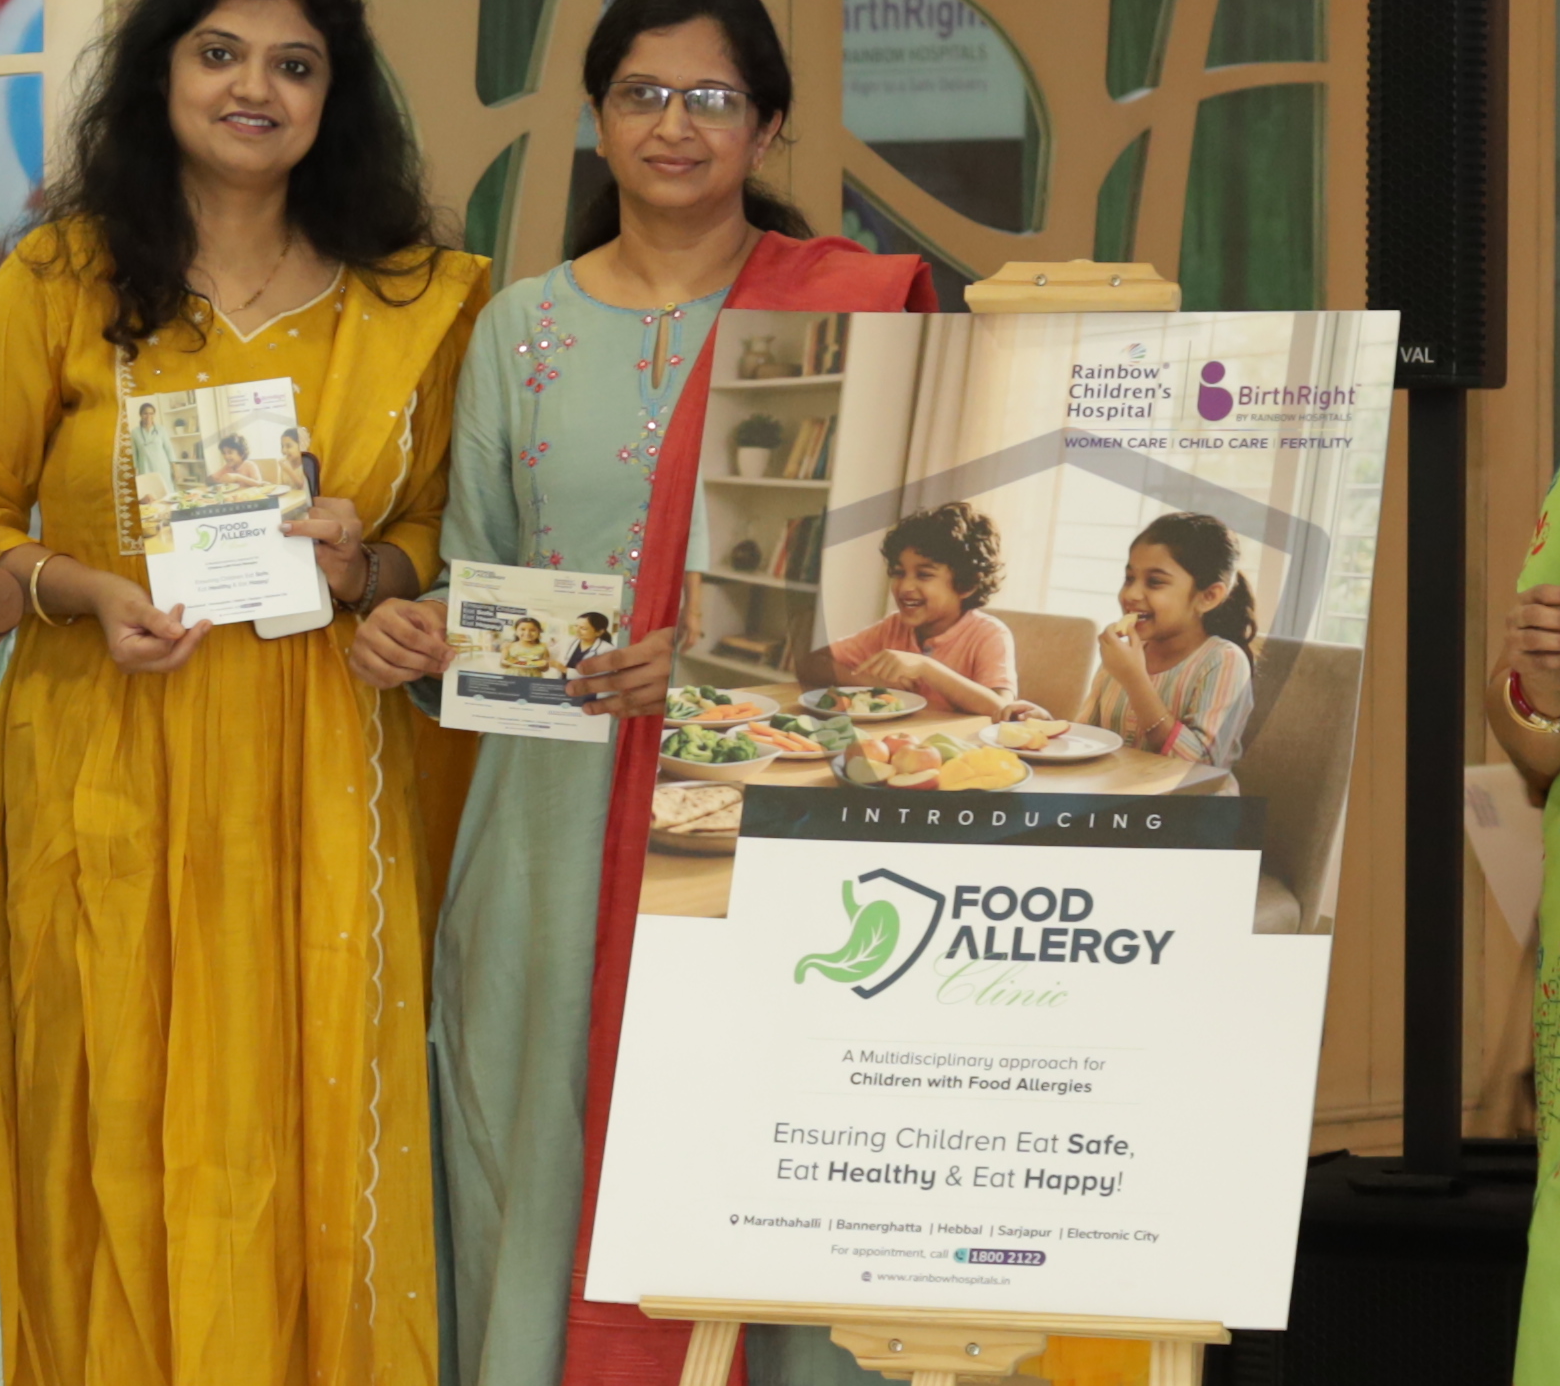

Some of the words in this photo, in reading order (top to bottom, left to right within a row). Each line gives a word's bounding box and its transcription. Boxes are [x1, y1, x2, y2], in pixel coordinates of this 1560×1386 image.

[1069, 382, 1172, 400] Children's
[1067, 402, 1153, 421] Hospital
[1251, 413, 1296, 421] RAINBOW
[1298, 413, 1352, 422] HOSPITALS
[1064, 437, 1123, 448] WOMEN
[1127, 437, 1167, 448] CARE
[1179, 437, 1223, 448] CHILD
[1228, 437, 1268, 448] CARE
[1280, 437, 1353, 449] FERTILITY
[219, 521, 248, 532] FOOD
[220, 527, 266, 541] ALLERGY
[842, 807, 1162, 830] INTRODUCING
[951, 885, 1094, 922] FOOD
[945, 925, 1175, 965] ALLERGY
[933, 946, 1069, 1008] Clinic
[842, 1049, 855, 1063] A
[859, 1049, 994, 1071] Multidisciplinary
[998, 1055, 1078, 1071] approach
[1083, 1056, 1106, 1071] for
[850, 1072, 922, 1088] Children
[927, 1074, 963, 1089] with
[969, 1076, 1011, 1091] Food
[1015, 1077, 1092, 1095] Allergies
[773, 1122, 886, 1153] Ensuring
[895, 1127, 1007, 1152] Children
[1016, 1132, 1059, 1154] Eat
[1067, 1133, 1135, 1160] Safe,
[776, 1158, 820, 1182] Eat
[828, 1161, 936, 1190] Healthy
[945, 1165, 963, 1186] &
[973, 1166, 1016, 1189] Eat
[1024, 1168, 1123, 1197] Happy!
[743, 1215, 821, 1229] Marathahalli
[836, 1219, 922, 1234] Bannerghatta
[937, 1223, 982, 1235] Hebbal
[997, 1225, 1052, 1238] Sarjapur
[1067, 1228, 1129, 1241] Electronic
[1134, 1230, 1159, 1243] City
[831, 1244, 849, 1255] For
[852, 1247, 926, 1259] appointment,
[930, 1248, 949, 1259] call
[970, 1251, 1004, 1263] 1800
[1007, 1252, 1041, 1265] 2122
[877, 1272, 1011, 1287] www.rainbowhospitals.in
